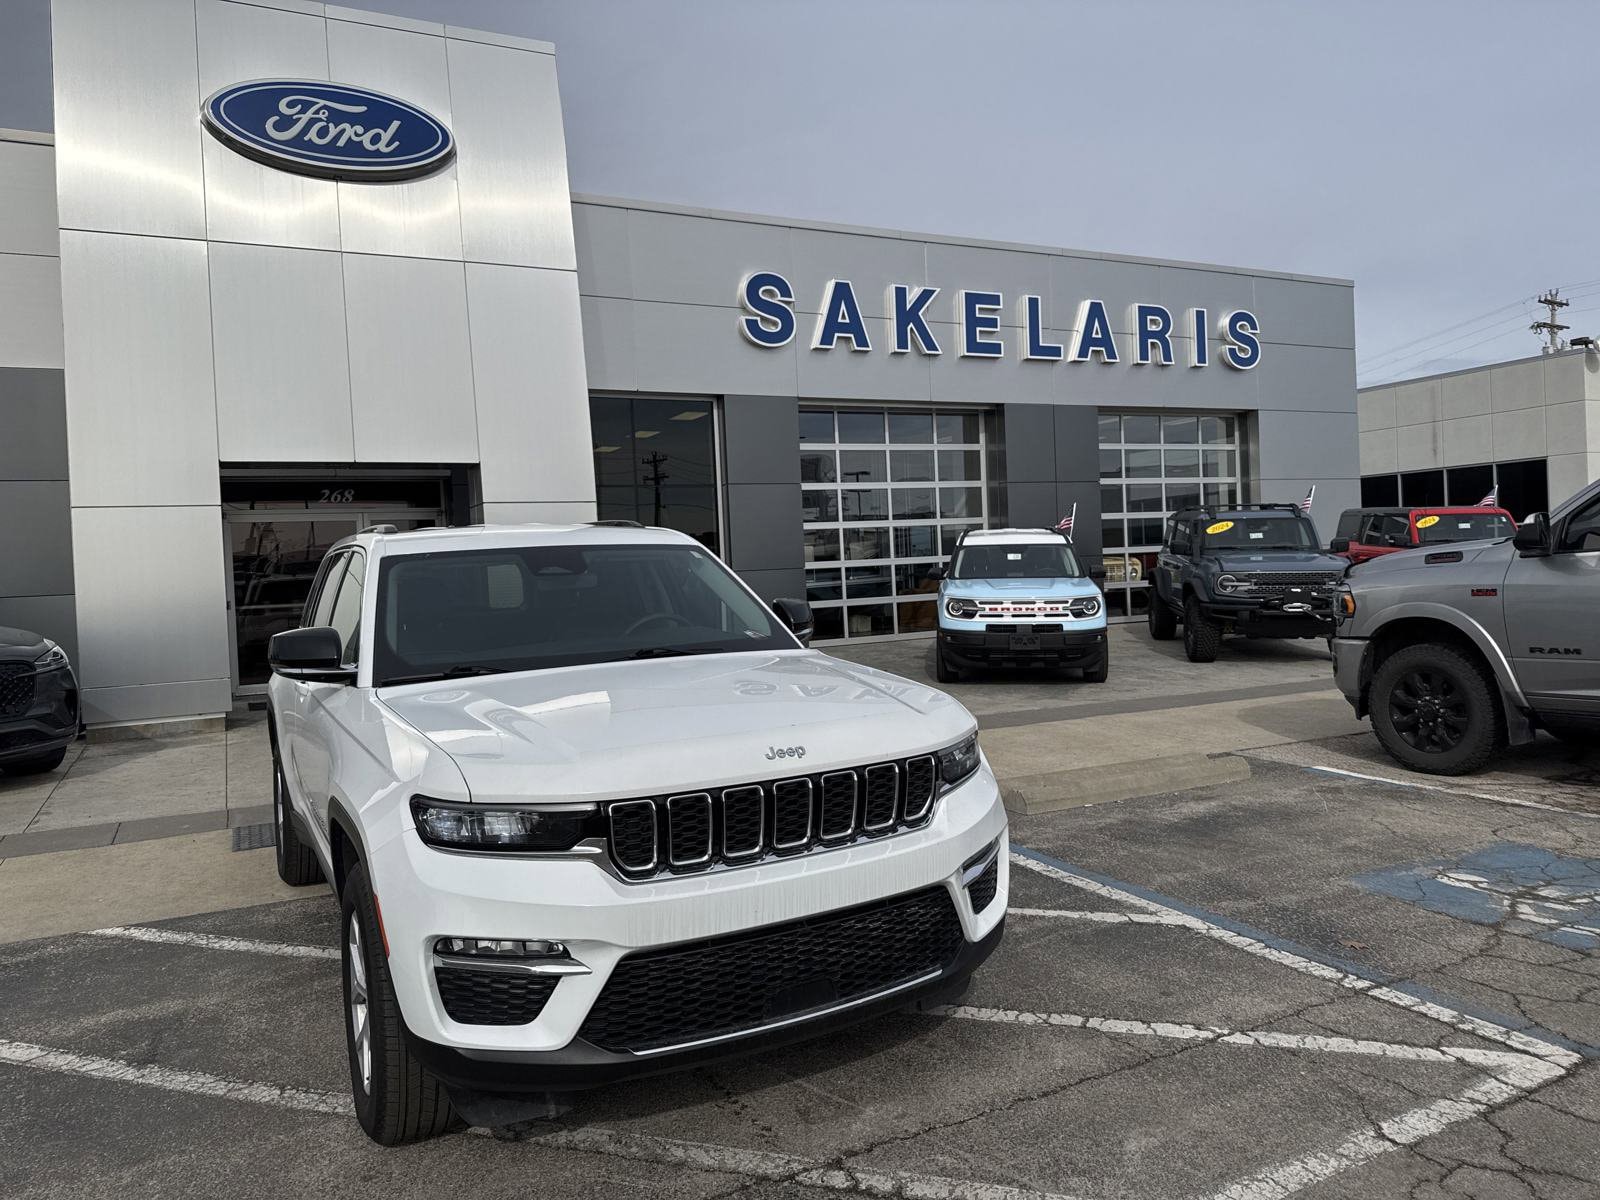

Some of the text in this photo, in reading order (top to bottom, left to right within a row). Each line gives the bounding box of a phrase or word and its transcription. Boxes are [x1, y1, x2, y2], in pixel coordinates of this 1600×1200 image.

[265, 95, 401, 153] Ford
[739, 271, 1261, 370] SAKELARIS
[319, 489, 355, 503] 268
[1528, 646, 1582, 656] RAM
[764, 745, 807, 760] Jeep
